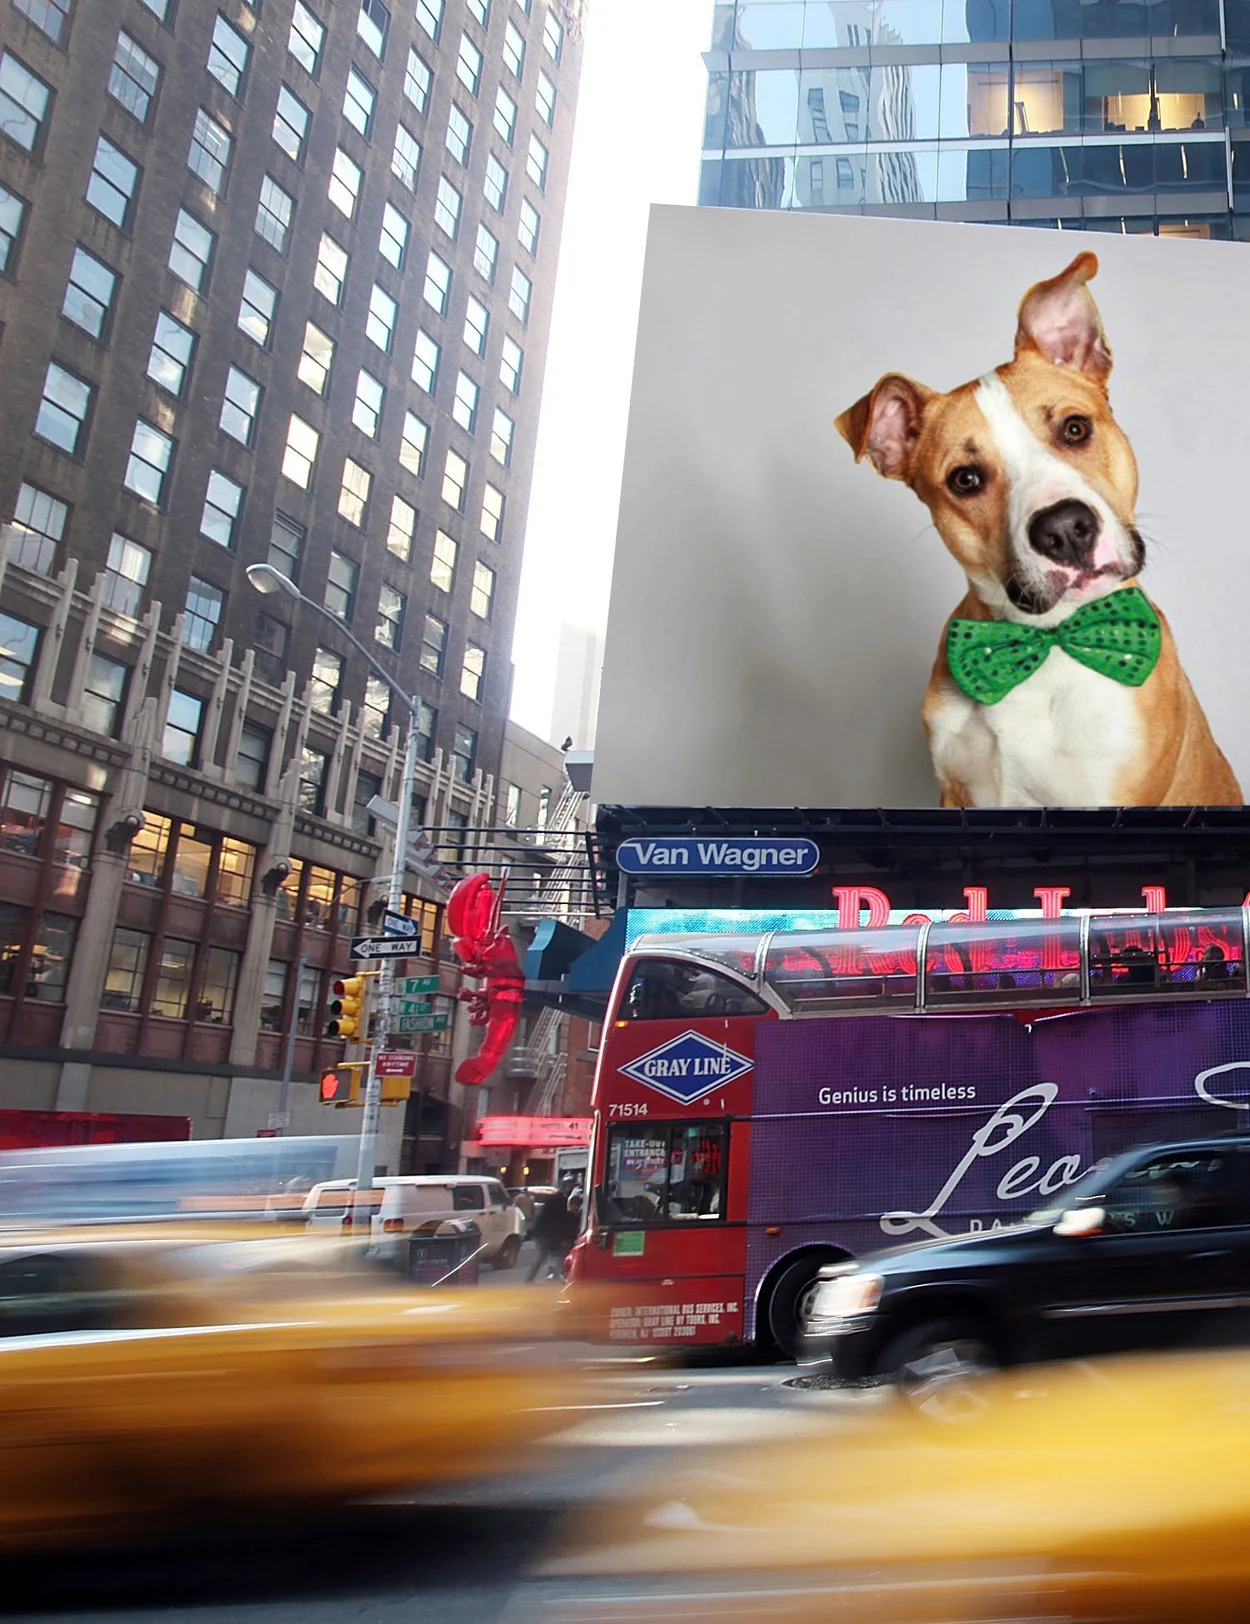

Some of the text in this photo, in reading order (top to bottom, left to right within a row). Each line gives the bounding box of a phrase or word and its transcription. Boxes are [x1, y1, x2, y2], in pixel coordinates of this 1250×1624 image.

[634, 842, 810, 871] Van Wagner
[360, 942, 413, 954] ONE WAY
[410, 979, 420, 993] 7
[401, 1016, 435, 1032] FASHION
[643, 1056, 732, 1078] GRAY LINE
[818, 1082, 977, 1105] Genius is timeless
[608, 1103, 649, 1118] 71514
